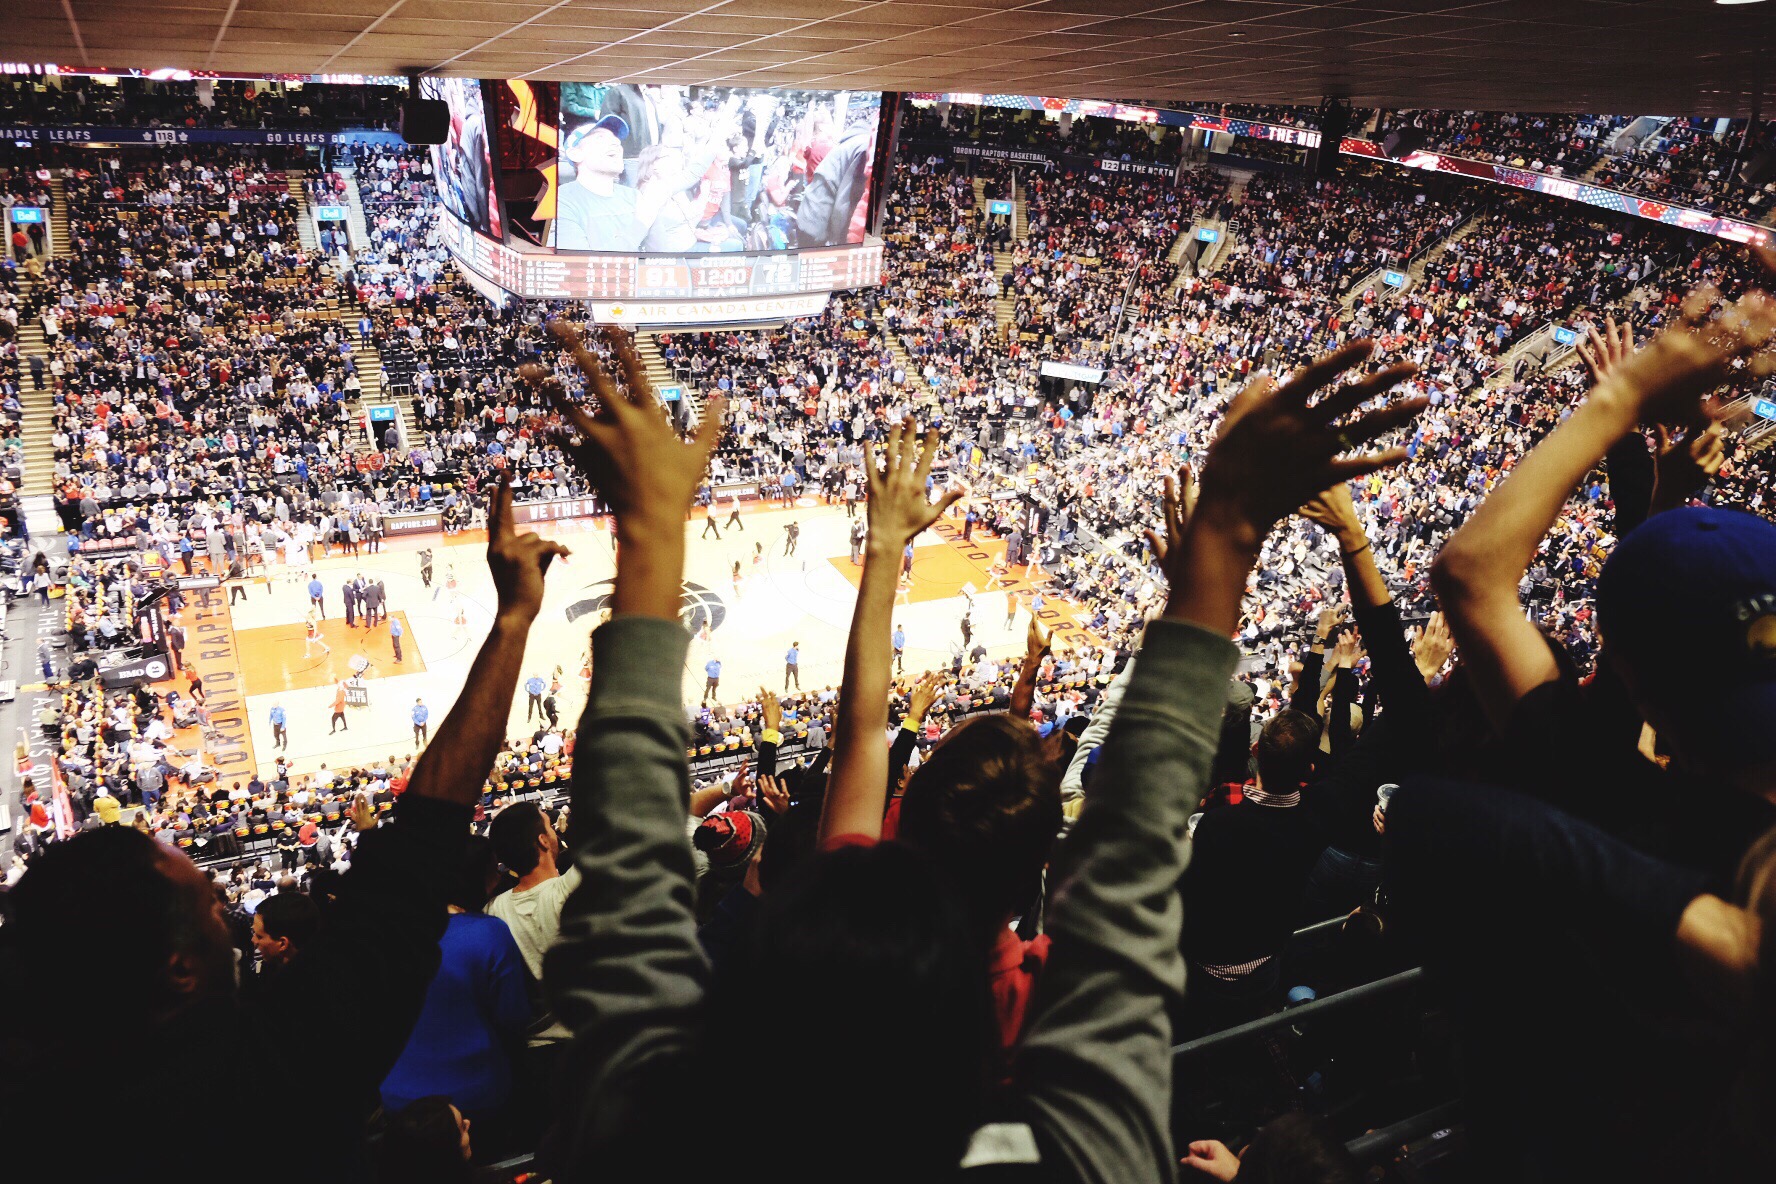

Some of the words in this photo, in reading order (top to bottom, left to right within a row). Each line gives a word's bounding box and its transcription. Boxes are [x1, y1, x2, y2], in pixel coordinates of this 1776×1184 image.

[50, 131, 91, 140] LEAFS
[157, 132, 174, 141] 118
[267, 134, 282, 142] GO
[289, 134, 325, 142] LEAFS
[331, 134, 346, 143] GO
[1269, 127, 1293, 143] THE
[953, 147, 980, 156] TORONTO
[982, 149, 1009, 158] RAPTORS
[1010, 151, 1047, 161] BASKETBALL
[1104, 161, 1118, 170] 122
[1132, 165, 1146, 174] THE
[1541, 176, 1579, 200] TIME
[700, 257, 746, 268] CITIZEN
[646, 268, 677, 286] 91
[698, 269, 747, 285] 12:00
[763, 264, 792, 283] 72
[638, 305, 667, 316] AIR
[676, 303, 747, 316] CANADA
[755, 299, 814, 312] CENTRE
[1557, 330, 1572, 342] Bell
[663, 390, 677, 399] Bell
[374, 410, 391, 419] Bell
[1758, 404, 1776, 416] Bell
[552, 502, 580, 517] THE
[391, 519, 438, 530] RAPTORS.COM
[38, 610, 58, 634] THE
[118, 669, 145, 679] BMO
[203, 671, 250, 783] TORONTO
